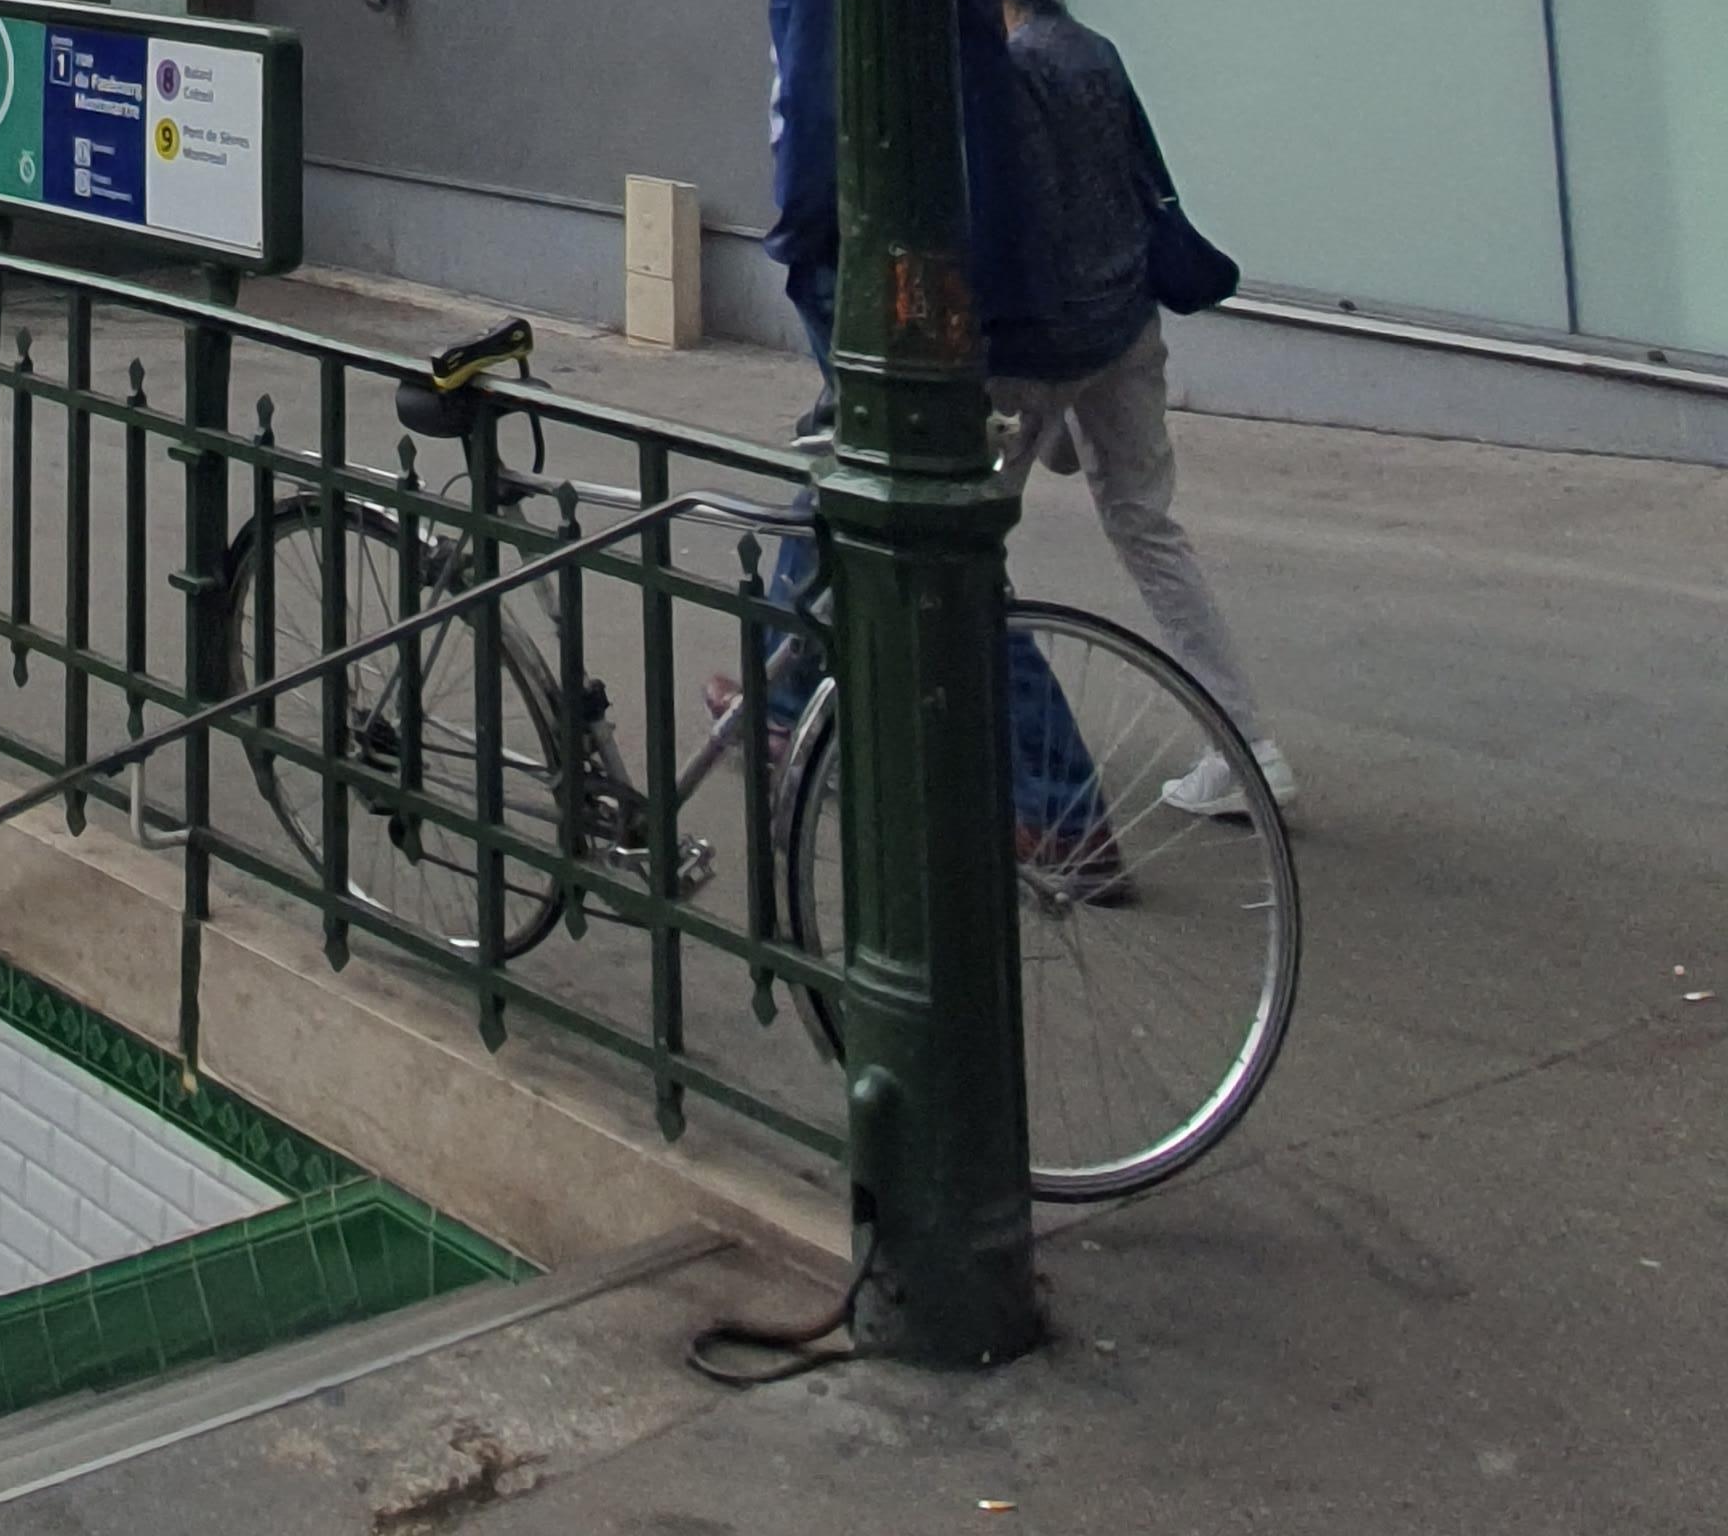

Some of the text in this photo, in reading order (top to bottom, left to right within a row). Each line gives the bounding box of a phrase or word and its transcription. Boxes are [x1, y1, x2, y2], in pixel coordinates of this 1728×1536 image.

[57, 52, 65, 78] 1
[162, 66, 175, 94] 8
[161, 125, 173, 153] 9
